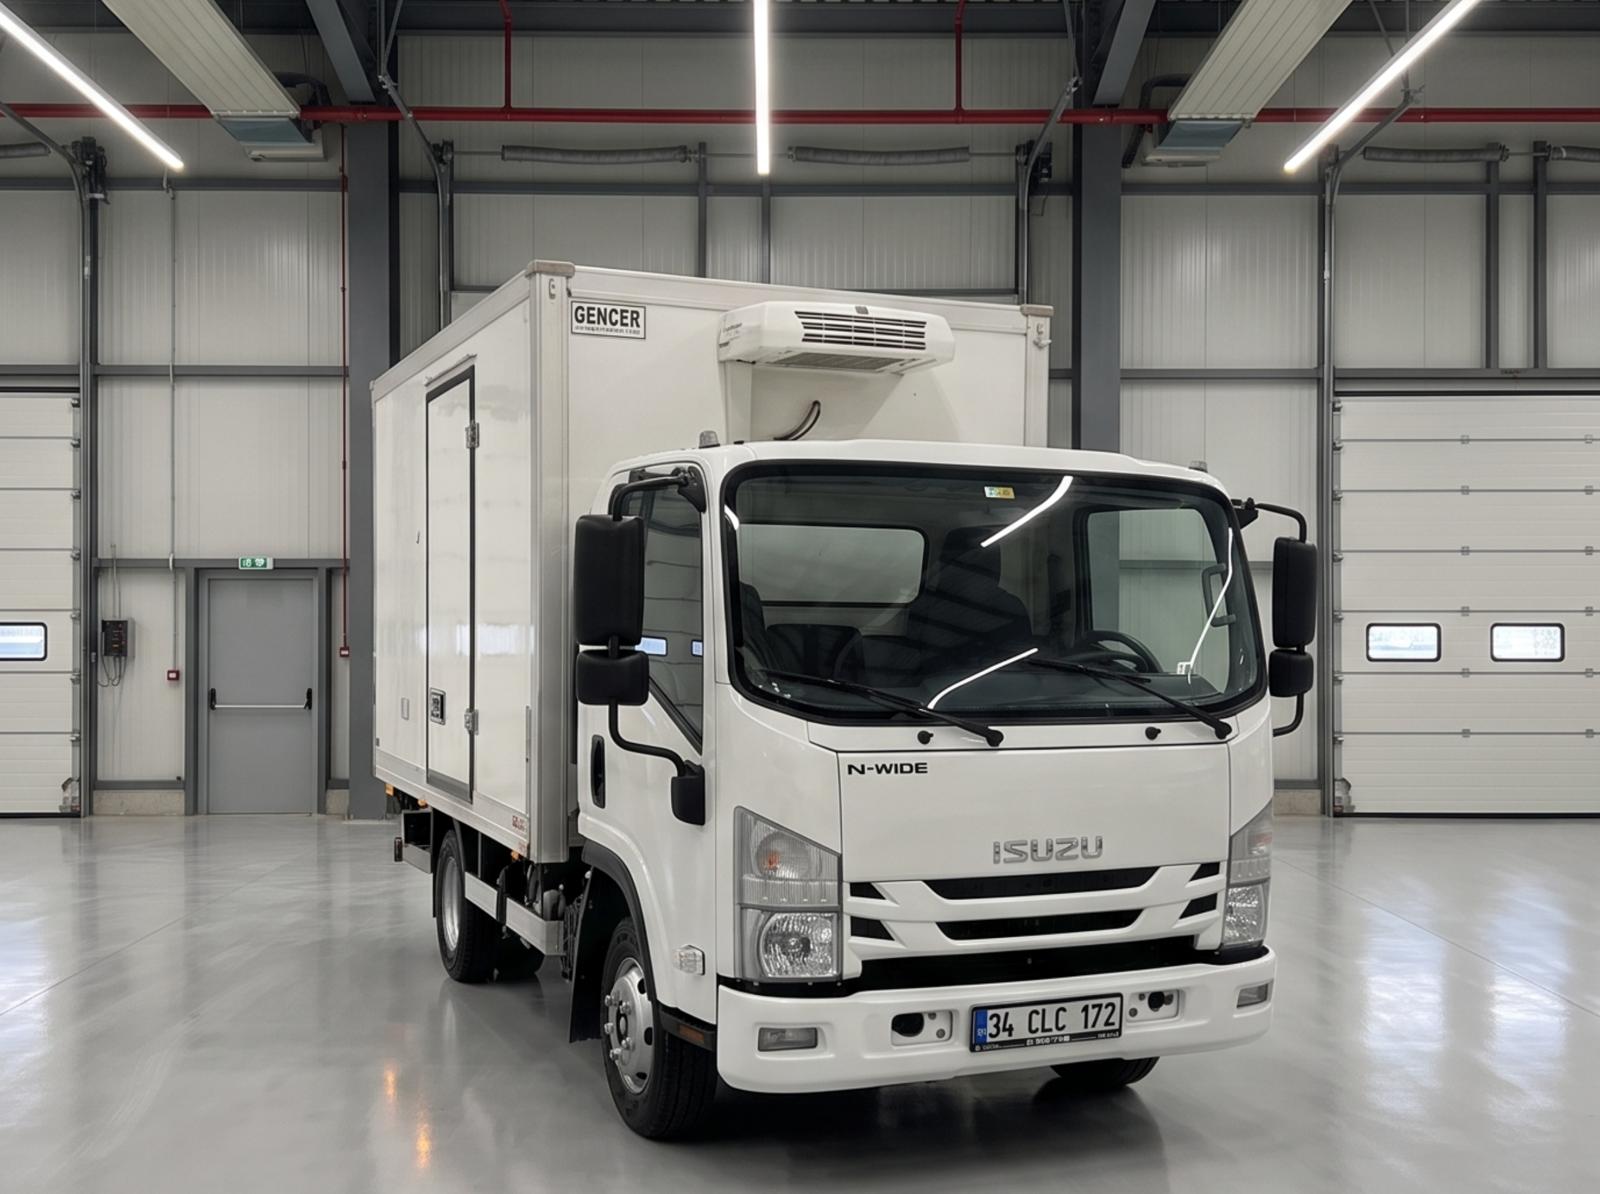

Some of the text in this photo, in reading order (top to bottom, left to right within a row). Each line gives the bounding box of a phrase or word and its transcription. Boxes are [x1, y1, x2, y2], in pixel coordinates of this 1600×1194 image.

[574, 305, 641, 328] GENCER
[847, 762, 928, 775] N-WIDE
[993, 835, 1103, 864] ISUZU
[988, 1002, 1116, 1039] 34 CLC 172
